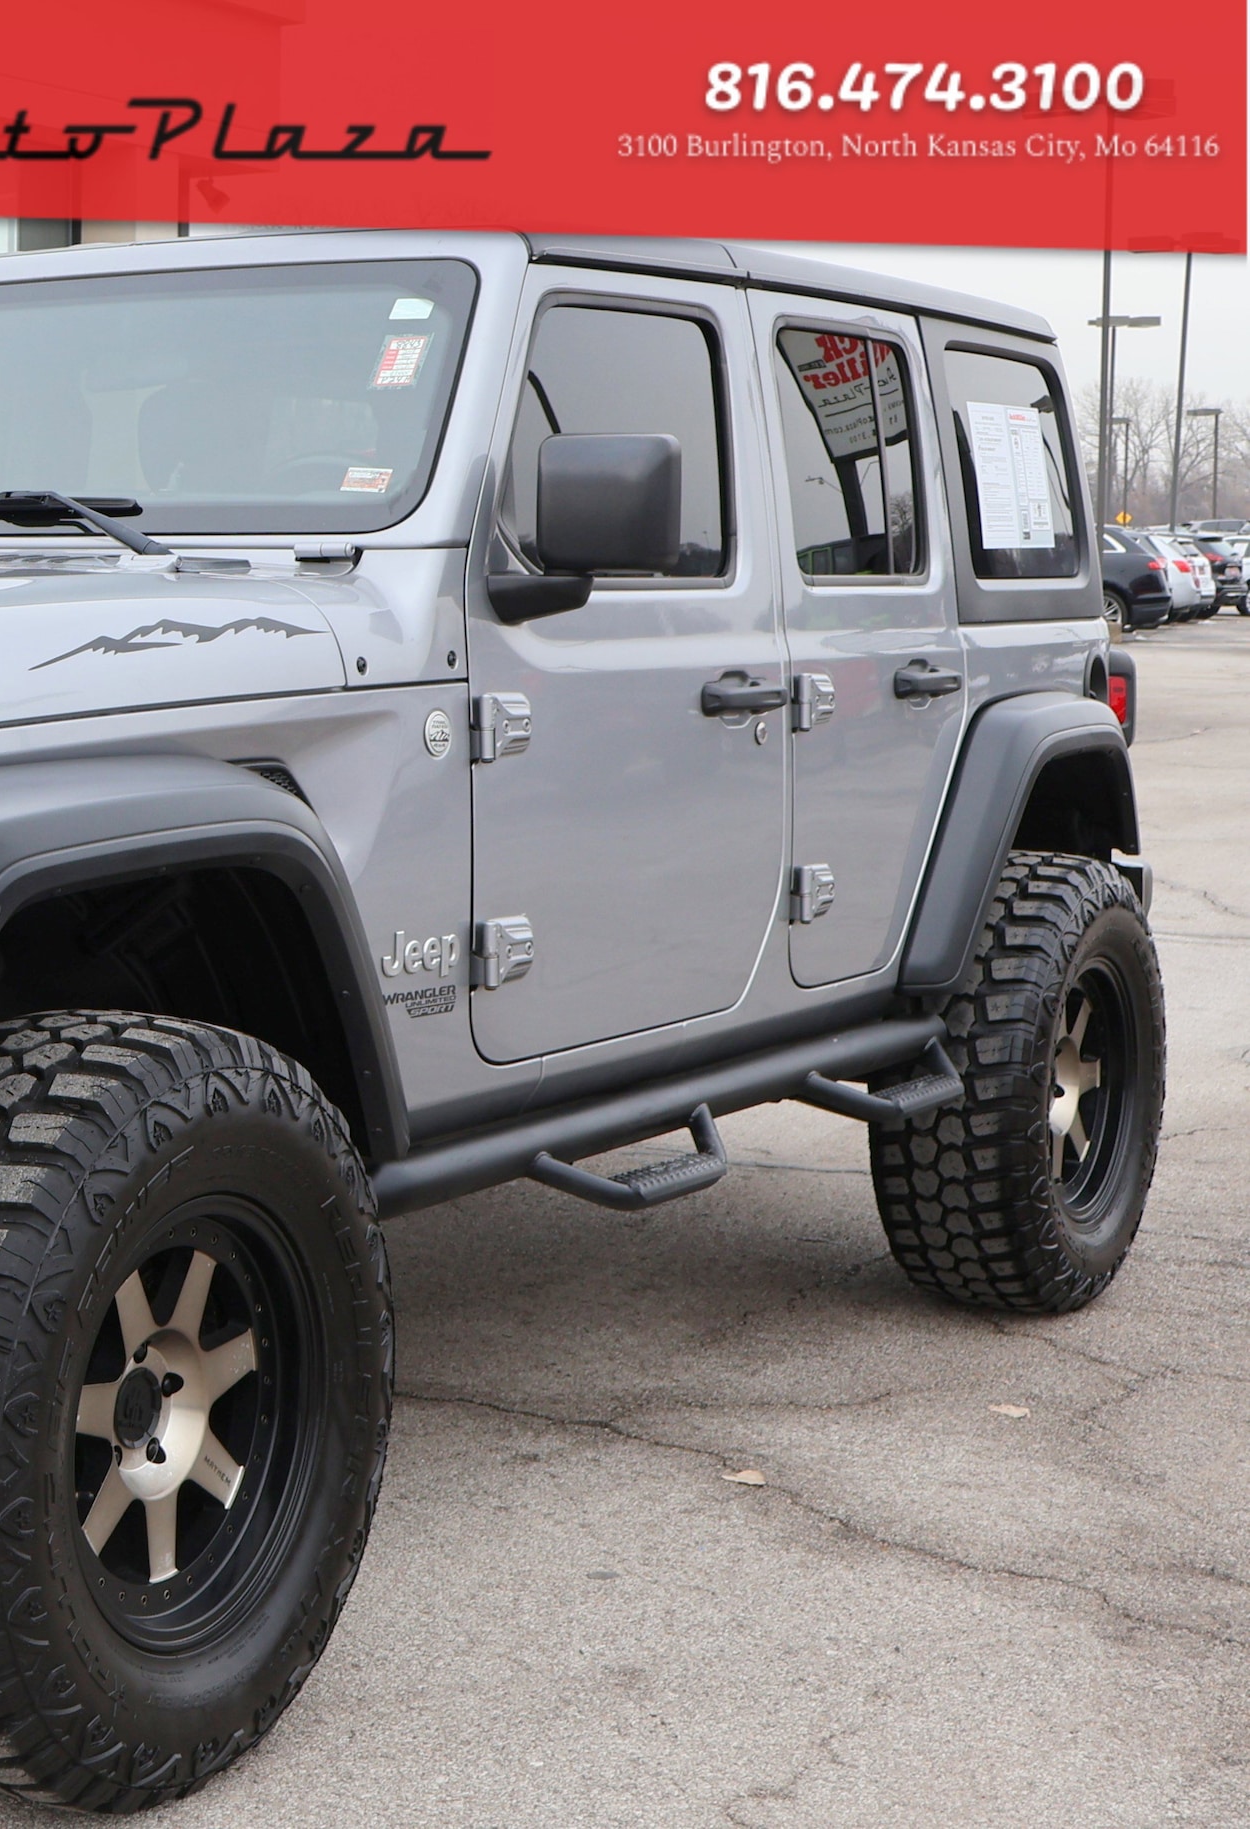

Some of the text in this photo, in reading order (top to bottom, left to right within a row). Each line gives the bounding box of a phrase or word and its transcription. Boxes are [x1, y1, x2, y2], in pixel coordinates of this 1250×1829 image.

[381, 930, 461, 978] Jeep
[382, 984, 456, 1006] WRANGLER
[405, 995, 456, 1009] UNLIMITED
[409, 1004, 454, 1017] SPORT
